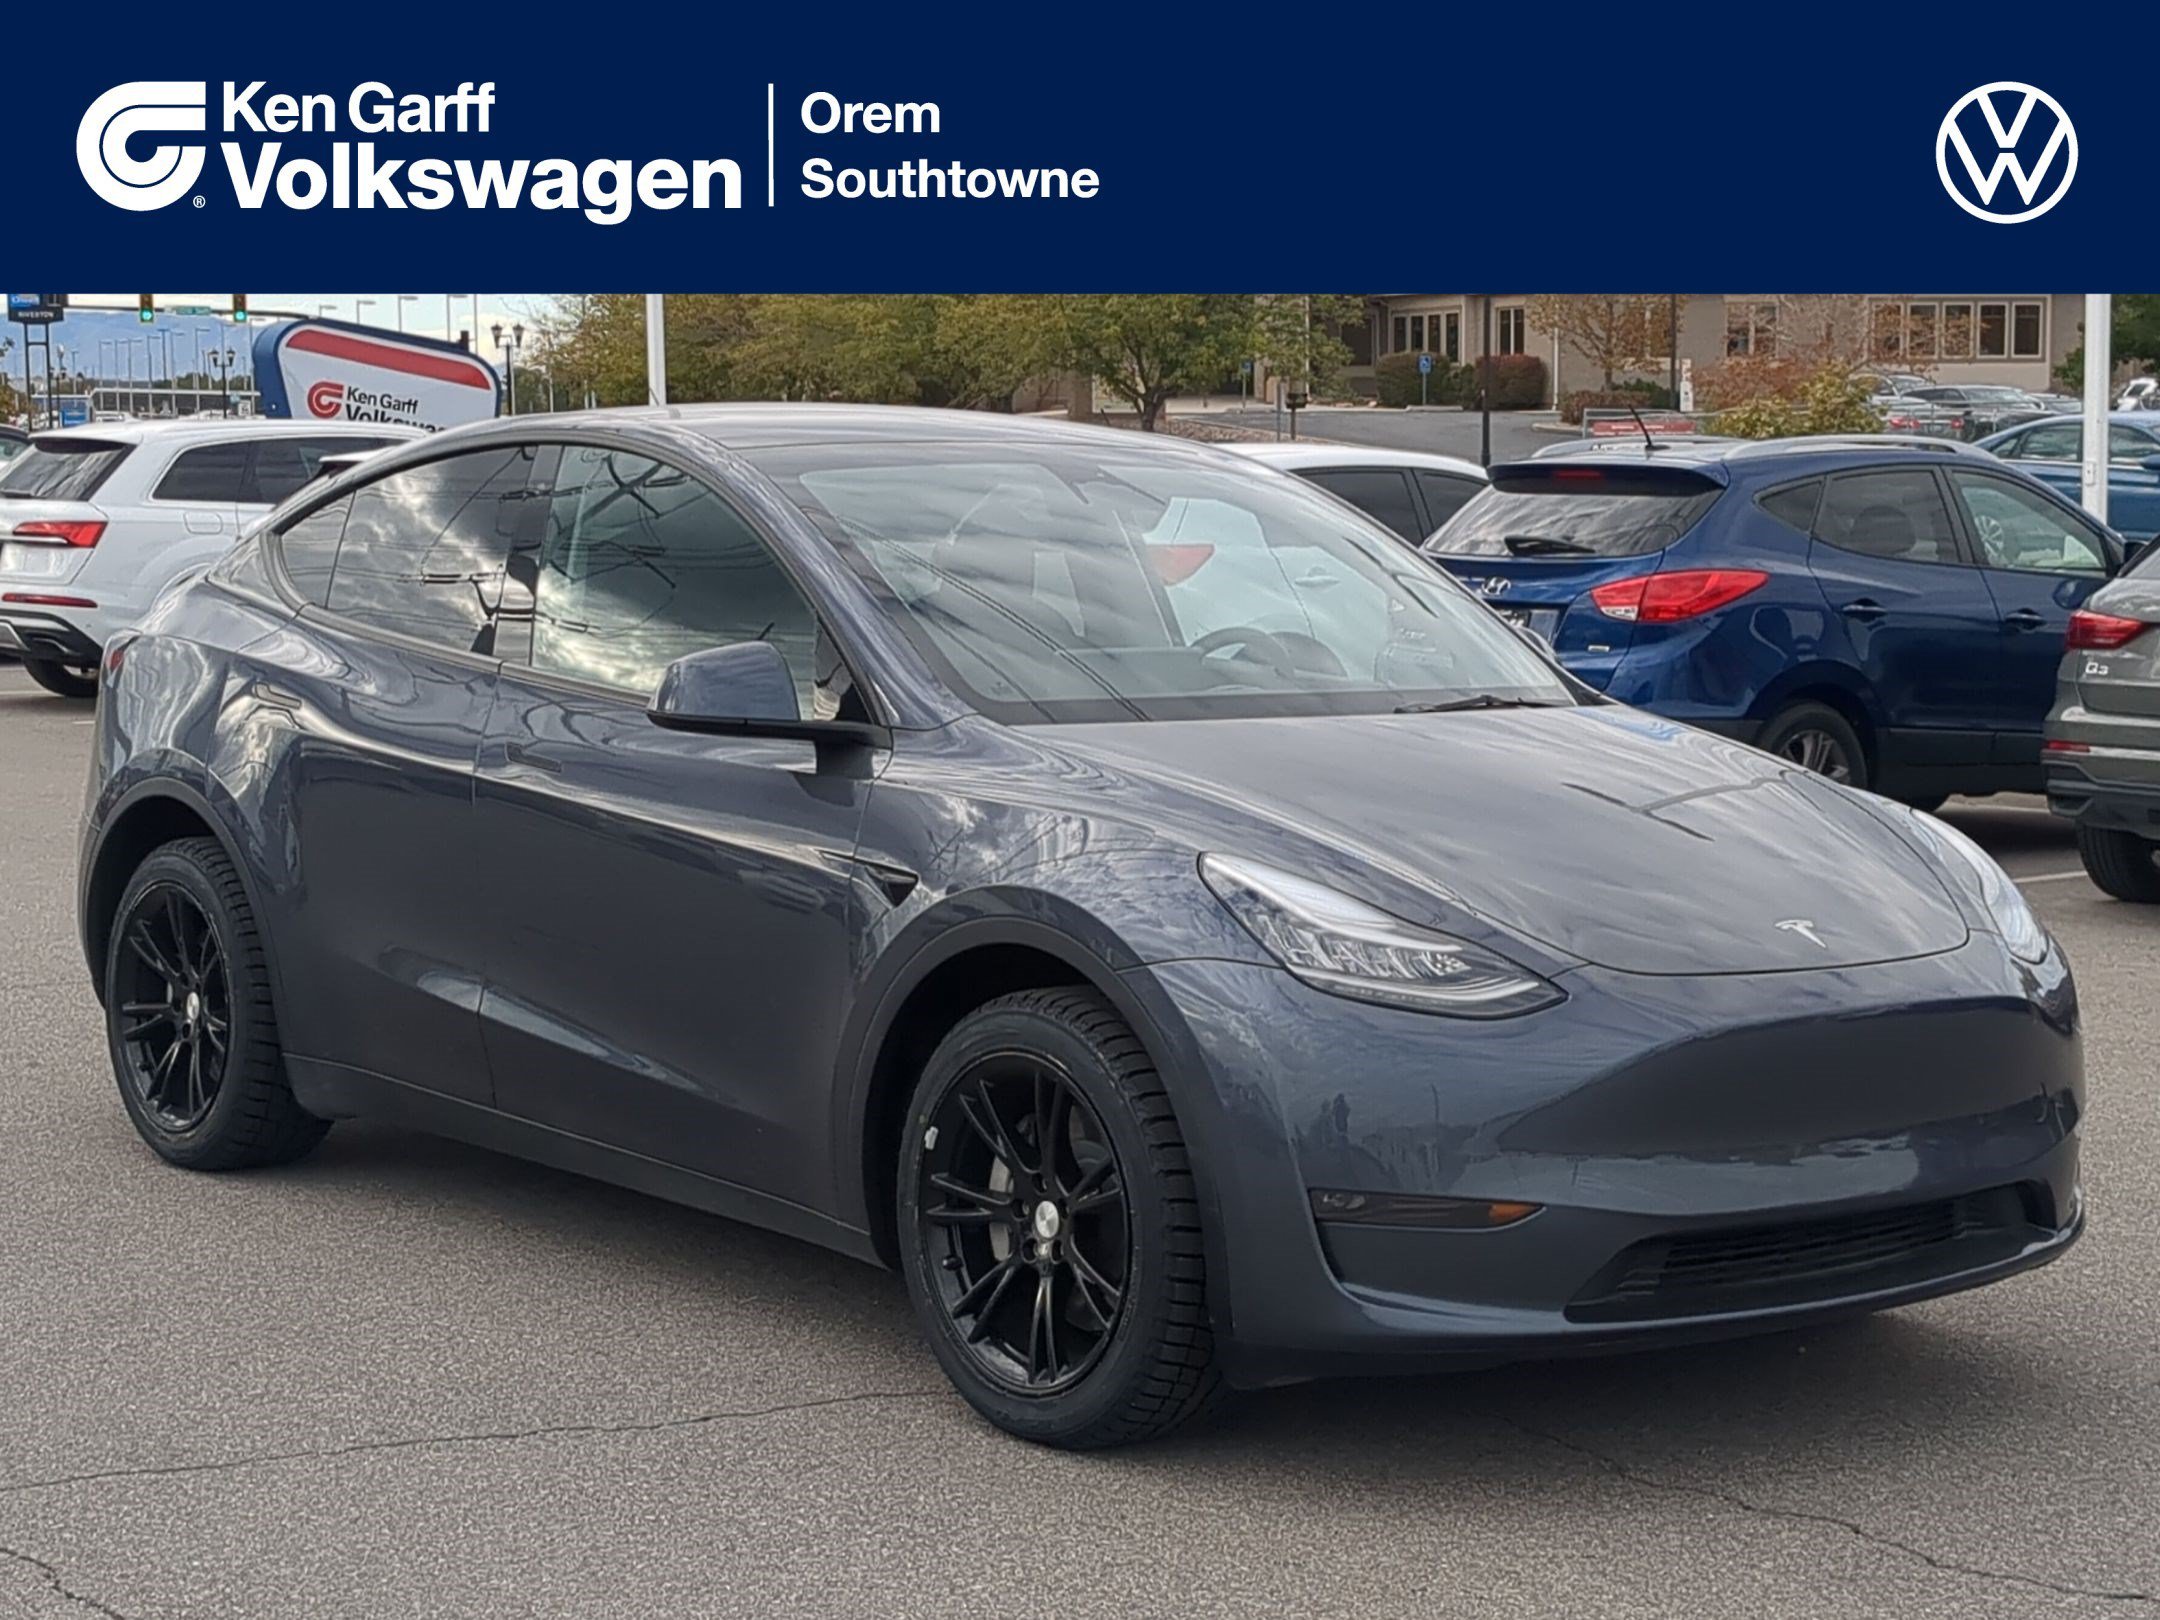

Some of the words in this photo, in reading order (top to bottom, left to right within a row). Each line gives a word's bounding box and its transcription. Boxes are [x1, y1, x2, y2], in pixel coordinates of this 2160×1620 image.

[347, 385, 377, 406] Ken
[380, 393, 419, 414] Garff
[2085, 662, 2109, 676] Q3
